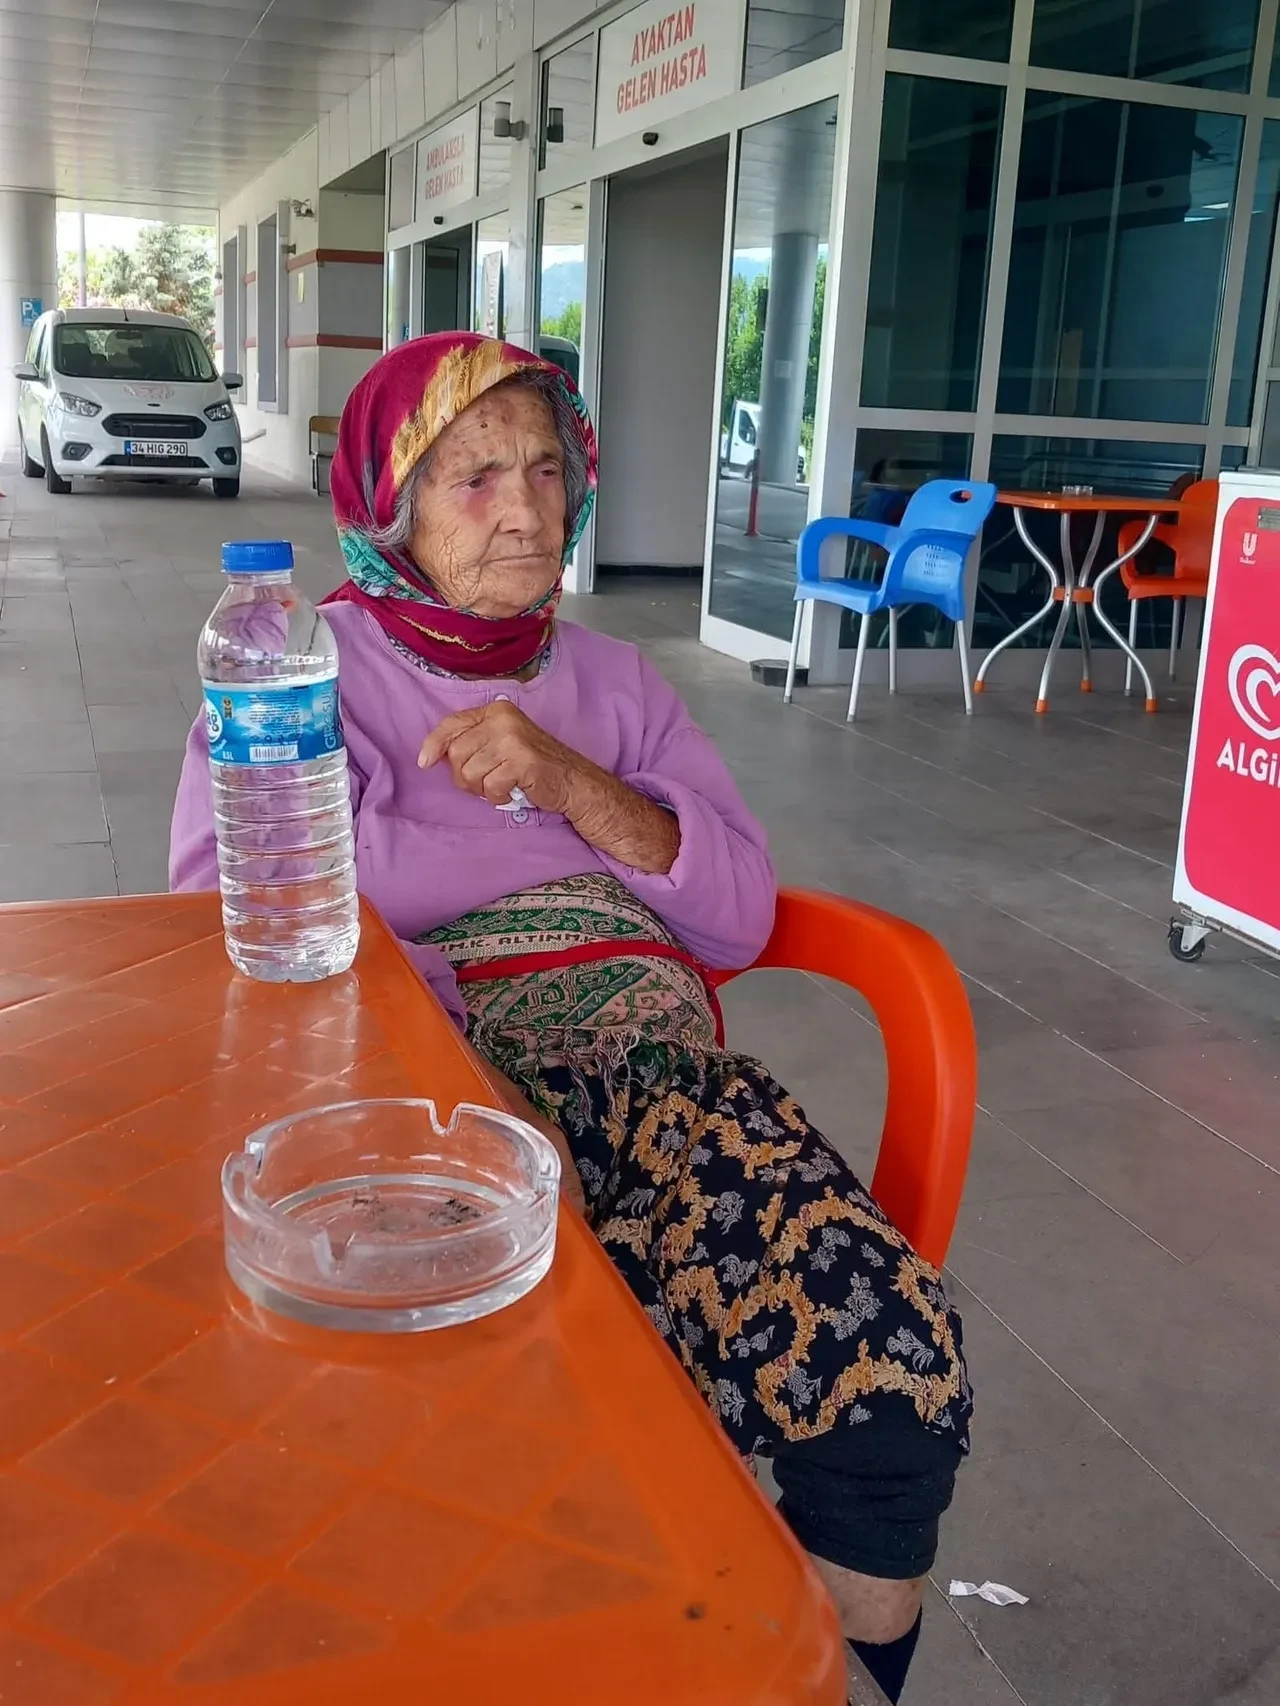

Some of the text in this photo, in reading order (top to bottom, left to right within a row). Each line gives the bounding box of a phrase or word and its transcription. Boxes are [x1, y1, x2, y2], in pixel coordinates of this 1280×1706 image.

[631, 3, 695, 67] AYAKTAN
[617, 44, 707, 114] GELEN HASTA
[132, 443, 186, 455] 34 HIG 290
[1216, 737, 1280, 789] ALGi
